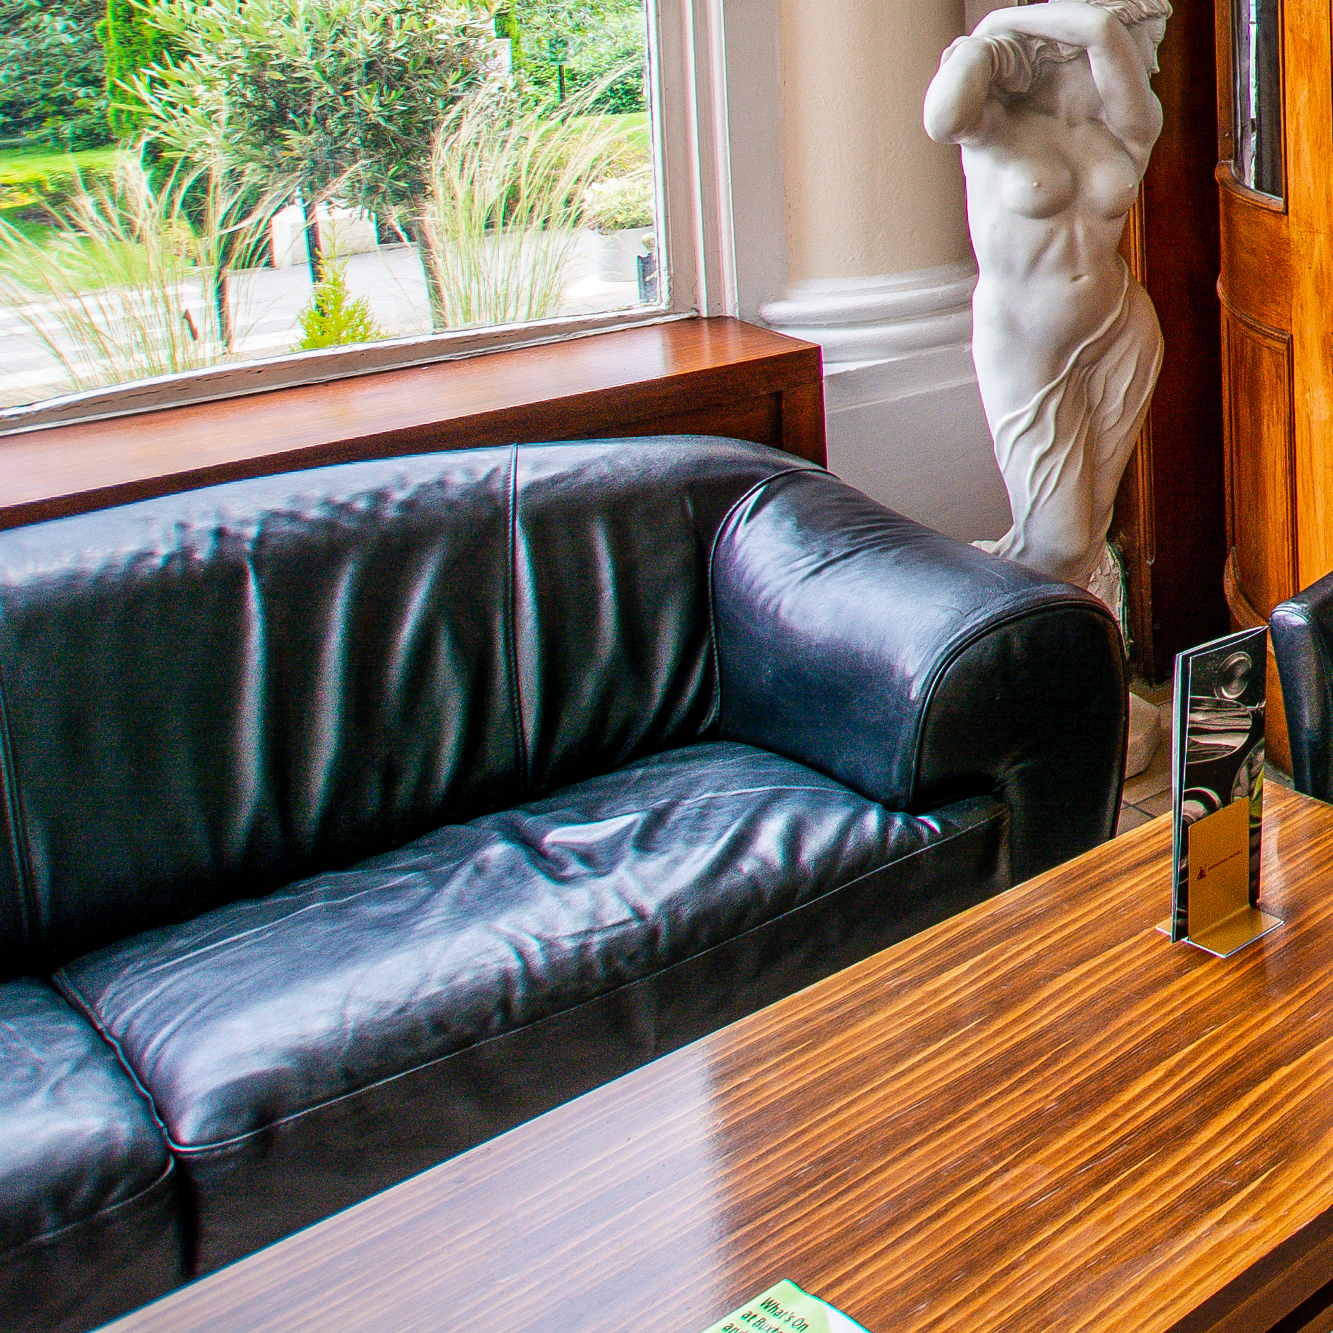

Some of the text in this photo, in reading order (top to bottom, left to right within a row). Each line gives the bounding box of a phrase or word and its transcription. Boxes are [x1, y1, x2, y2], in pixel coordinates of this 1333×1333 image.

[741, 1310, 758, 1322] at
[760, 1297, 810, 1332] What's On
[722, 1322, 750, 1333] an
